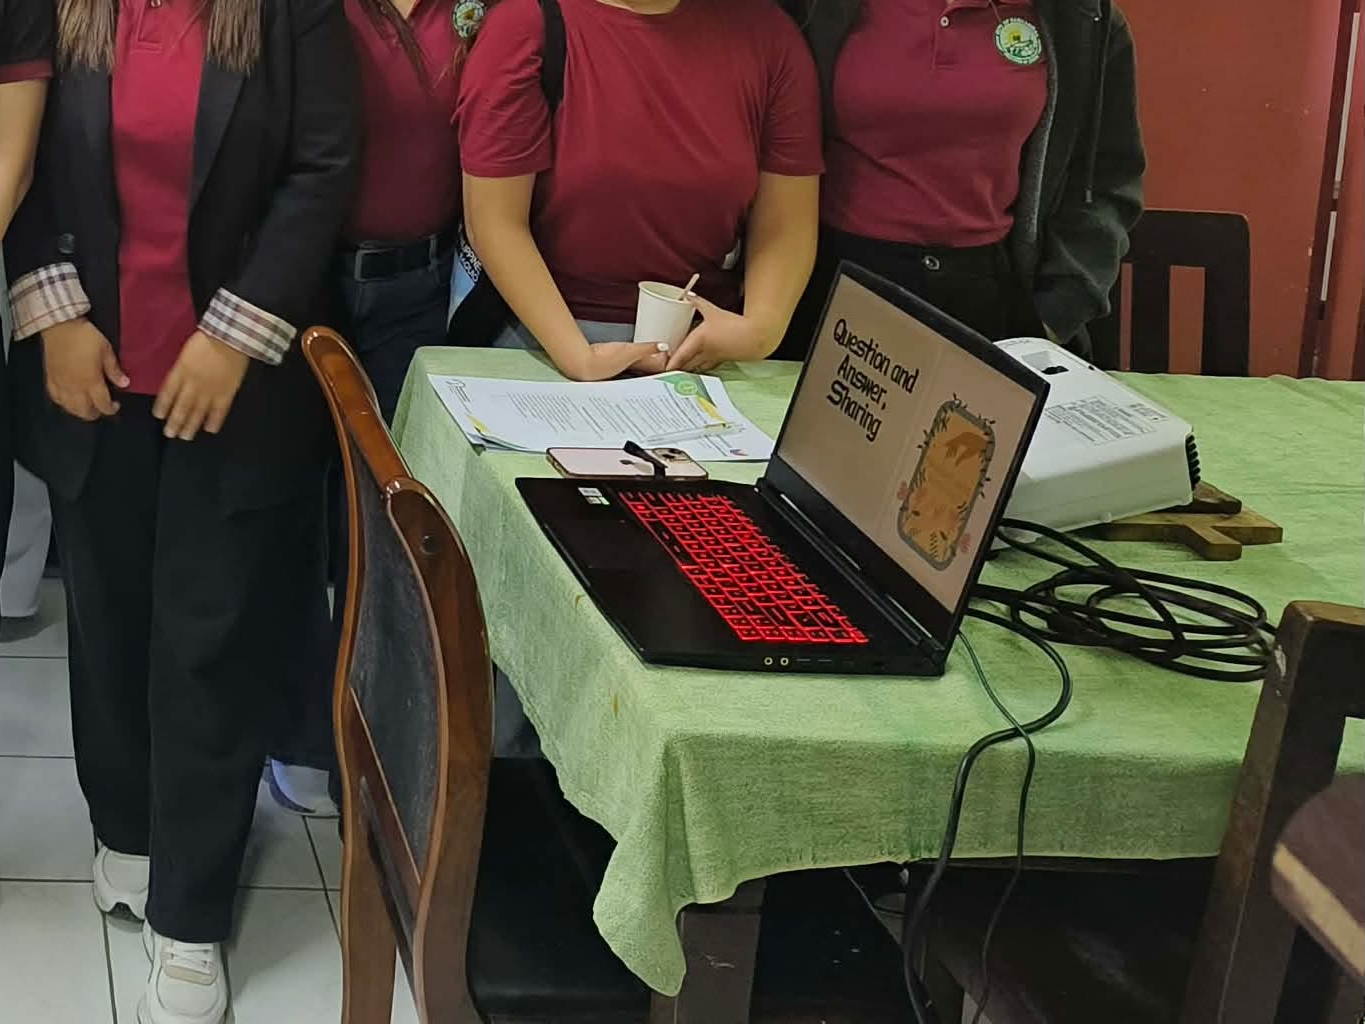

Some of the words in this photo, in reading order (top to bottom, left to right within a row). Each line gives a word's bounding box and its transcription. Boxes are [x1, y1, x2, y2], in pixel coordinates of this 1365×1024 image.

[833, 318, 891, 377] Question
[890, 364, 920, 394] and
[826, 379, 883, 443] Sharing
